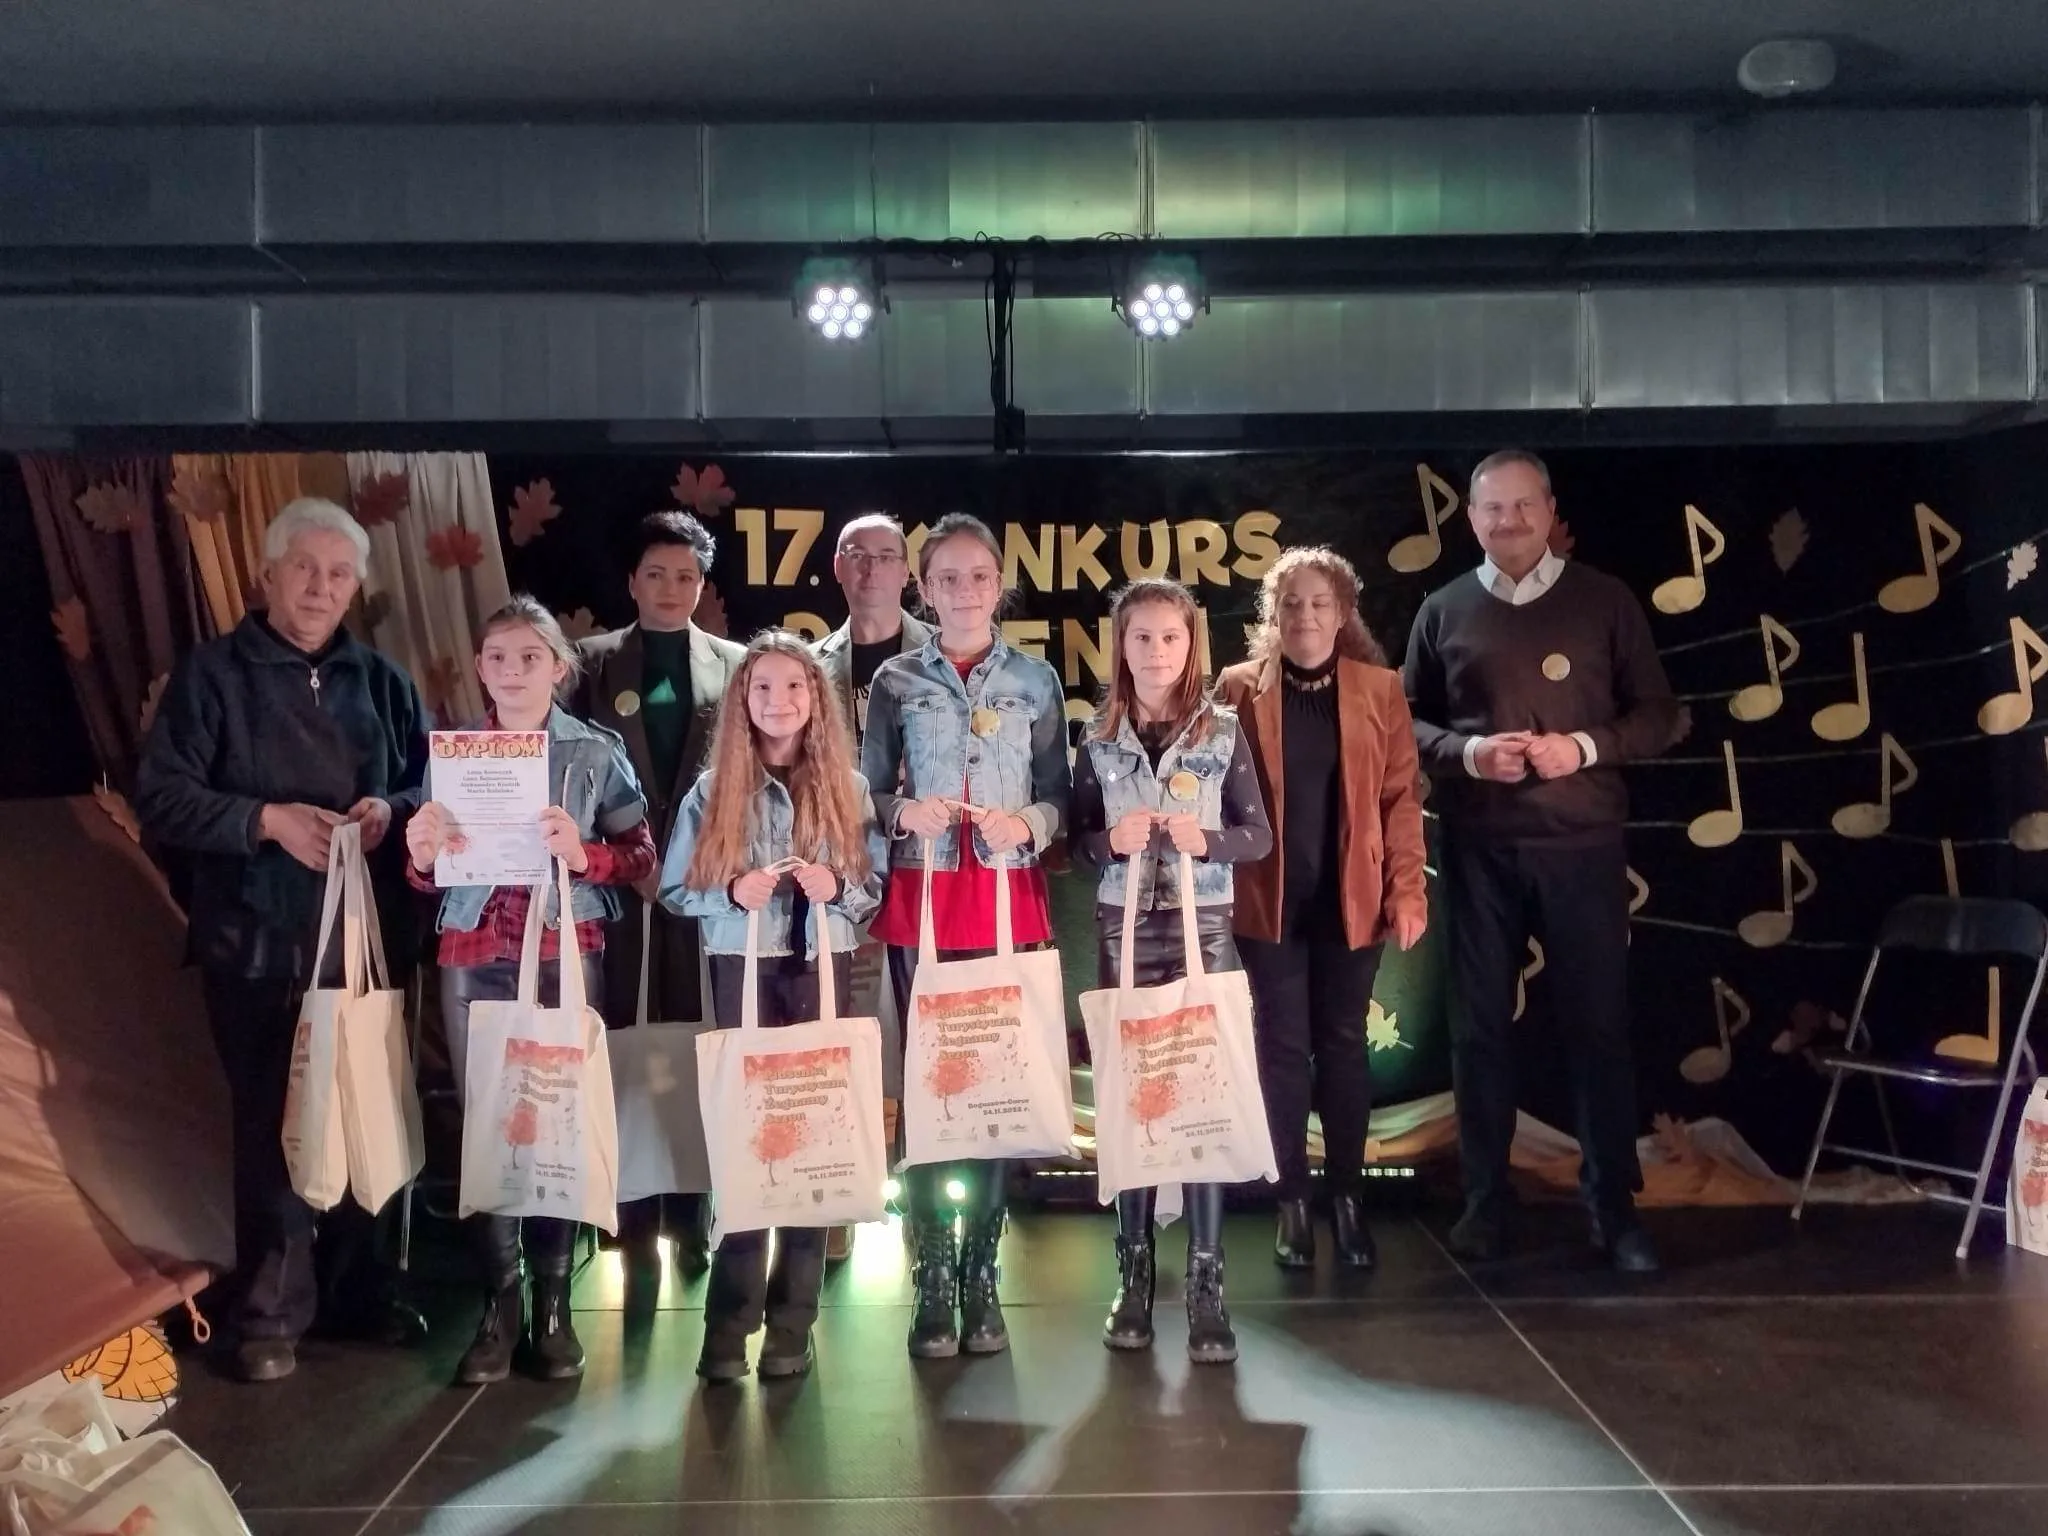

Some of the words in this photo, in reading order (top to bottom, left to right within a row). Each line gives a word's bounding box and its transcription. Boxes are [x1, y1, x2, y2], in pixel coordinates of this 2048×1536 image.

[735, 508, 825, 586] 17.
[905, 510, 1282, 591] NKURS
[436, 738, 543, 759] DYPLOM
